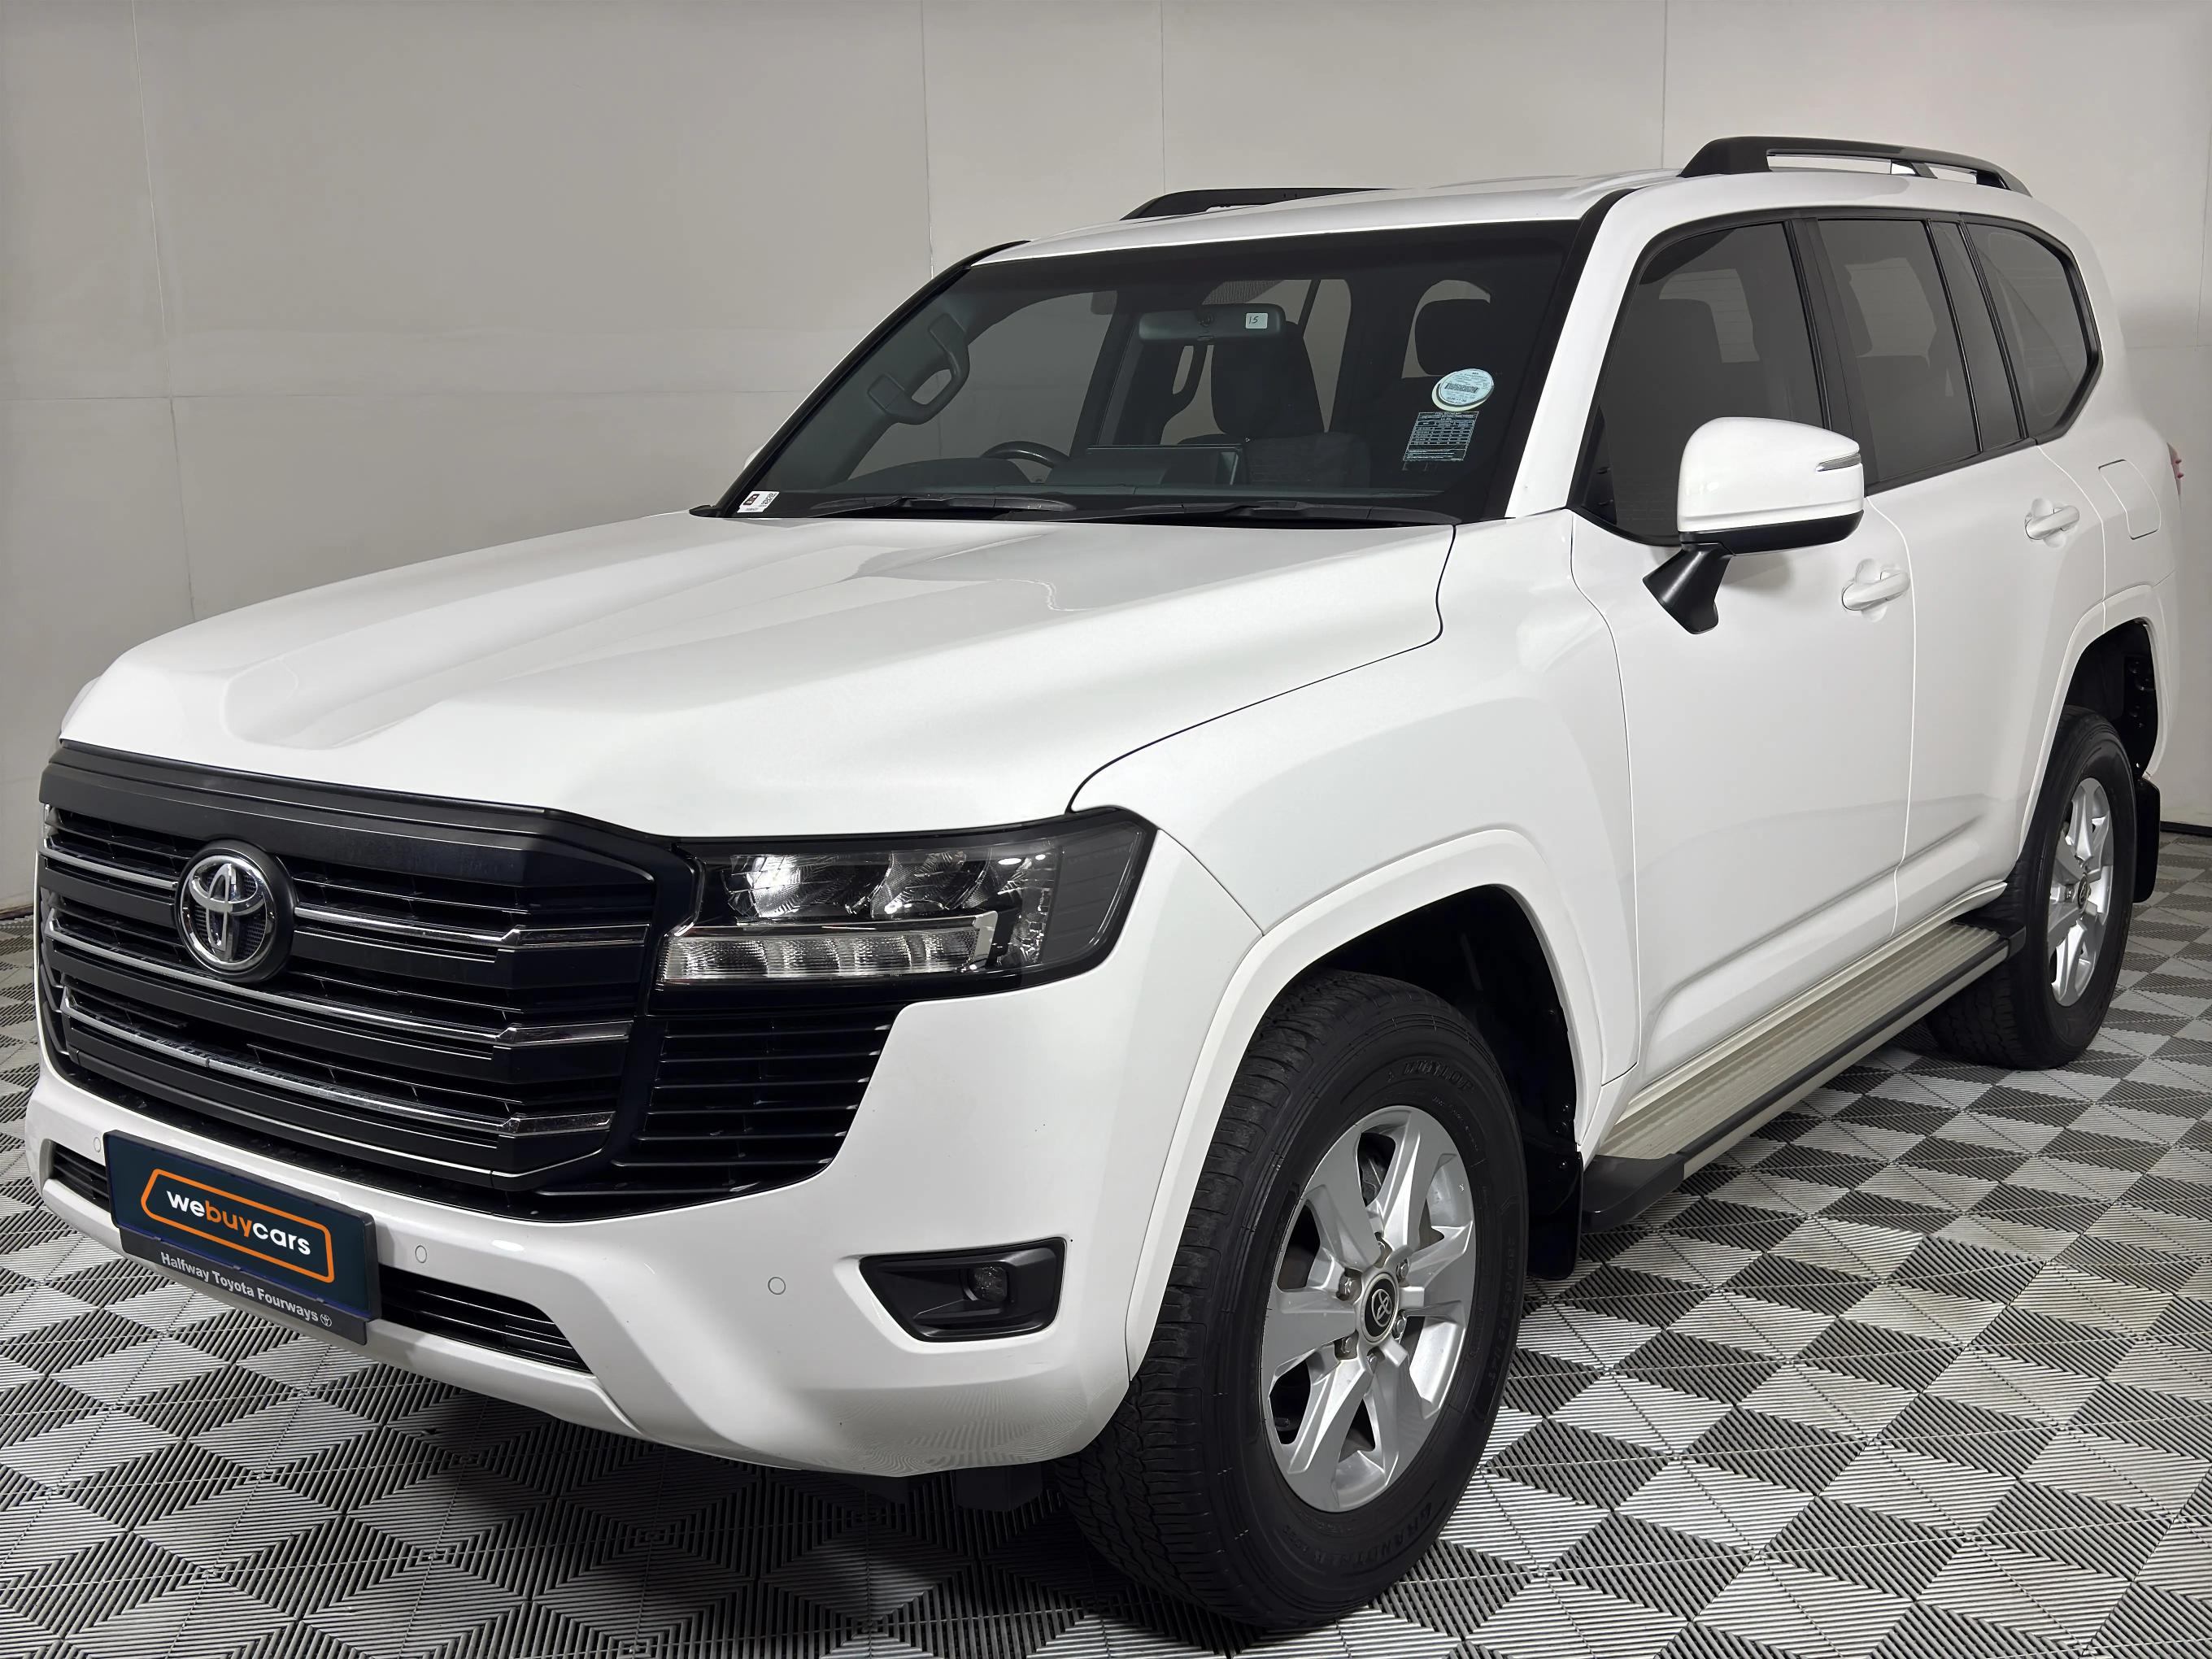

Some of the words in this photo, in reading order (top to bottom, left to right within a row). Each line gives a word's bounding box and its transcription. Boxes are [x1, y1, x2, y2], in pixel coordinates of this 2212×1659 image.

[167, 1190, 311, 1255] webuycars
[160, 1252, 209, 1282] Halfway
[211, 1270, 255, 1297] Toyota
[258, 1288, 319, 1322] Fourways
